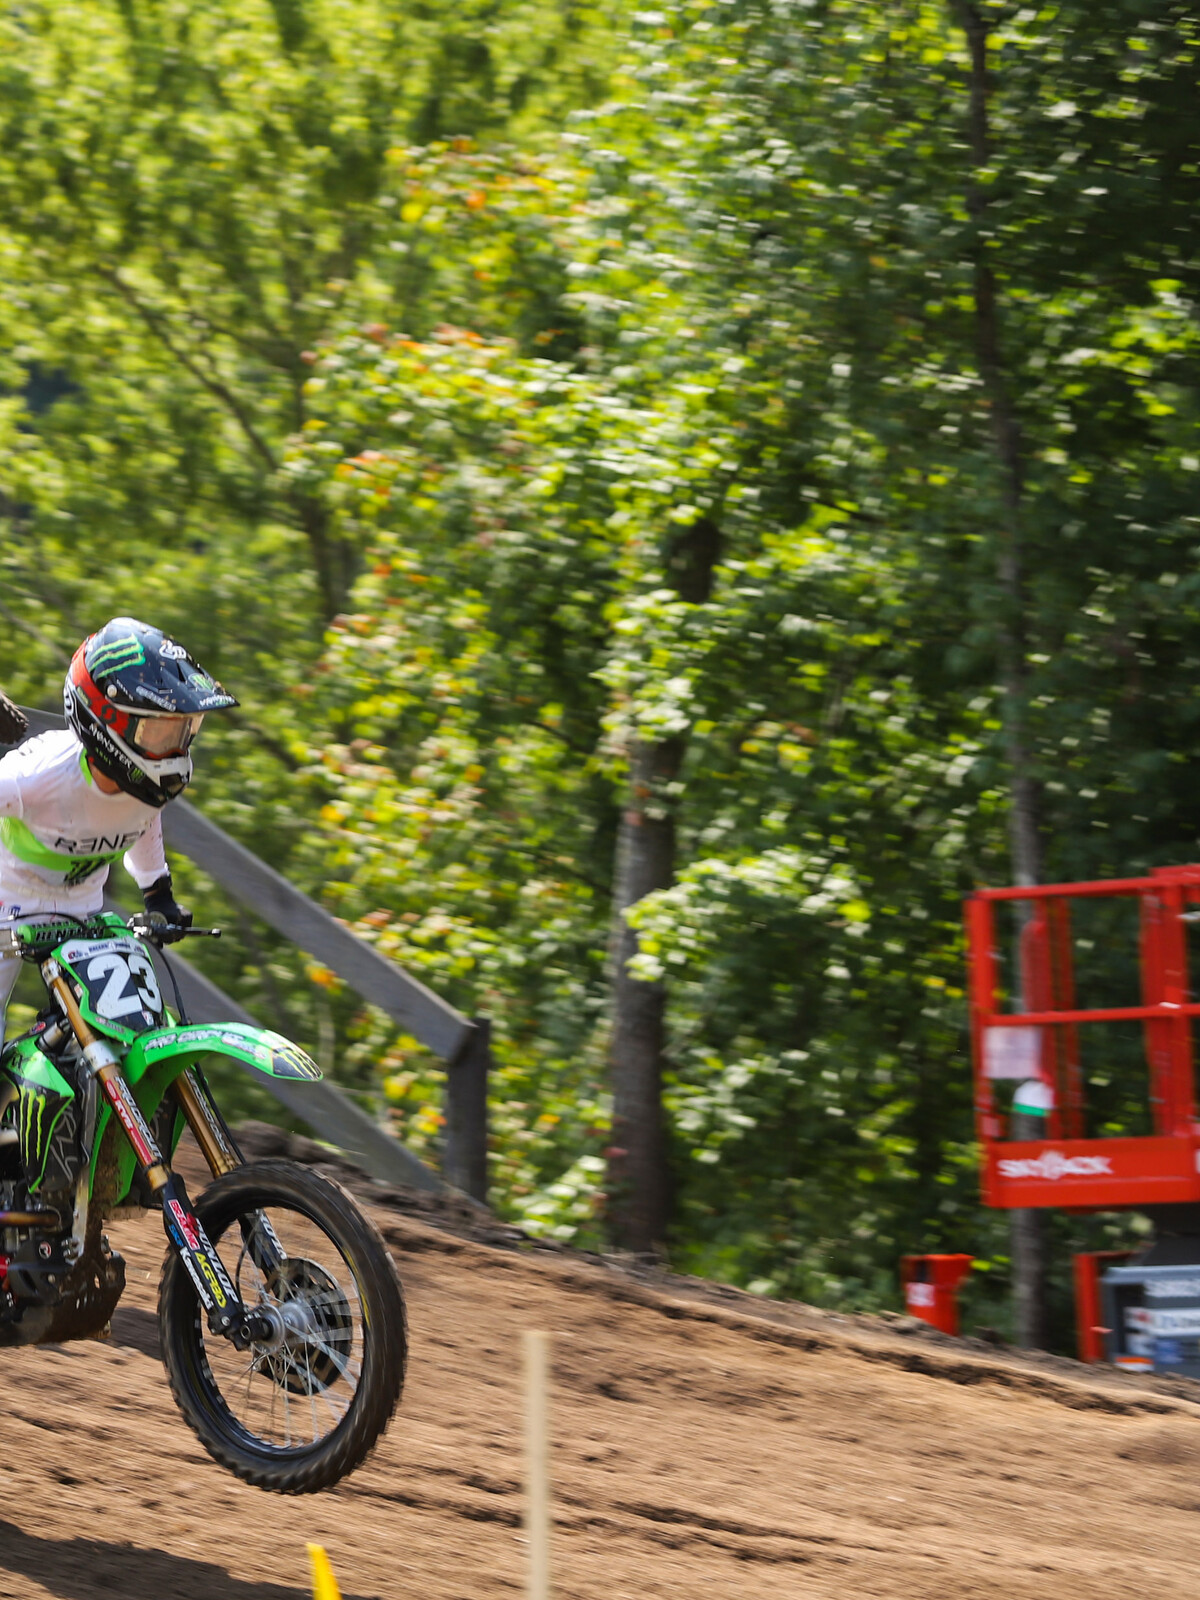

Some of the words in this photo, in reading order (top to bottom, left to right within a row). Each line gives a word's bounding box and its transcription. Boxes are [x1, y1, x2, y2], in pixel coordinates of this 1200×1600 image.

[88, 722, 133, 768] MONSTER
[87, 953, 162, 1020] 23
[180, 1247, 214, 1310] Kawasaki
